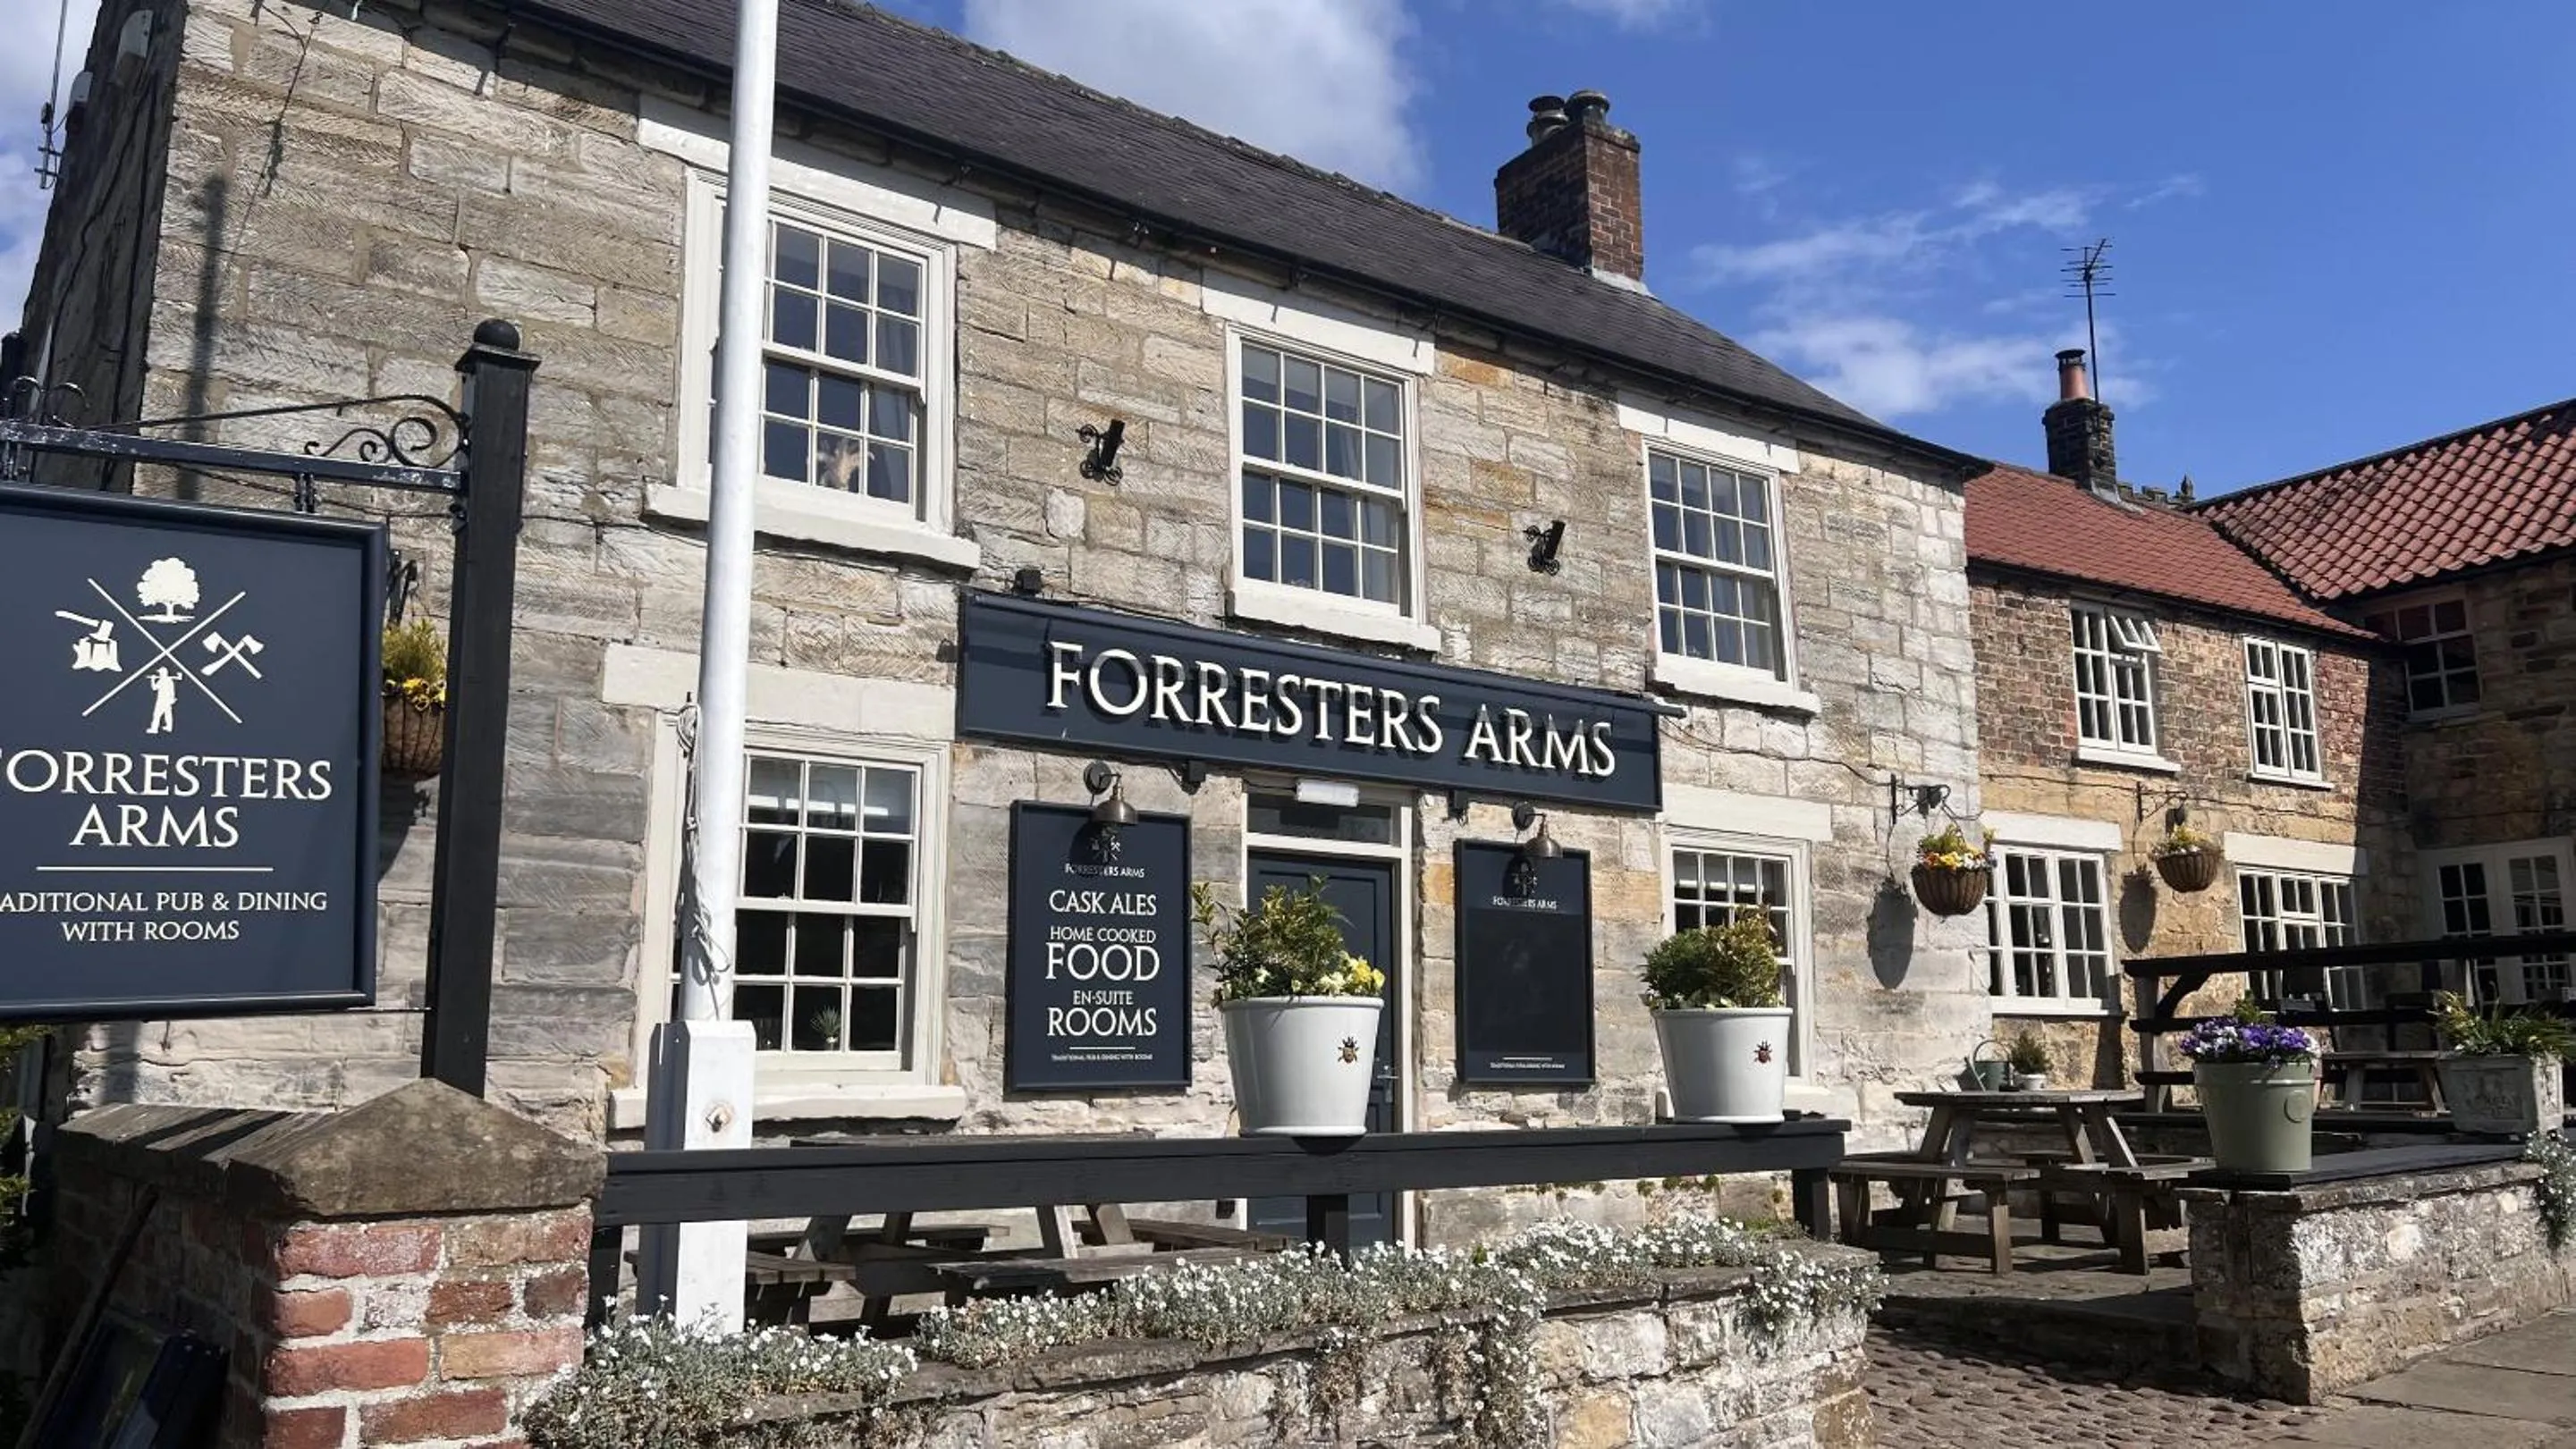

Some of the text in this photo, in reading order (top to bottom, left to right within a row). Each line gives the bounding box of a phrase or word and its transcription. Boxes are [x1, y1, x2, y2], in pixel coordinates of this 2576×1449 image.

[1047, 640, 1616, 777] FORRESTERS ARMS
[0, 747, 333, 801] ORRESTERS
[69, 803, 240, 848] ARMS
[1119, 865, 1144, 878] ARMS
[156, 892, 205, 912] PUB
[212, 891, 230, 912] &
[238, 891, 327, 912] DINING
[1049, 889, 1157, 916] CASK ALES
[61, 920, 240, 942] WITH ROOMS
[1050, 925, 1157, 944] HOME COOKED
[1045, 942, 1161, 981] FOOD
[1072, 990, 1134, 1006] EN-SUITE
[1046, 1007, 1157, 1037] ROOMS
